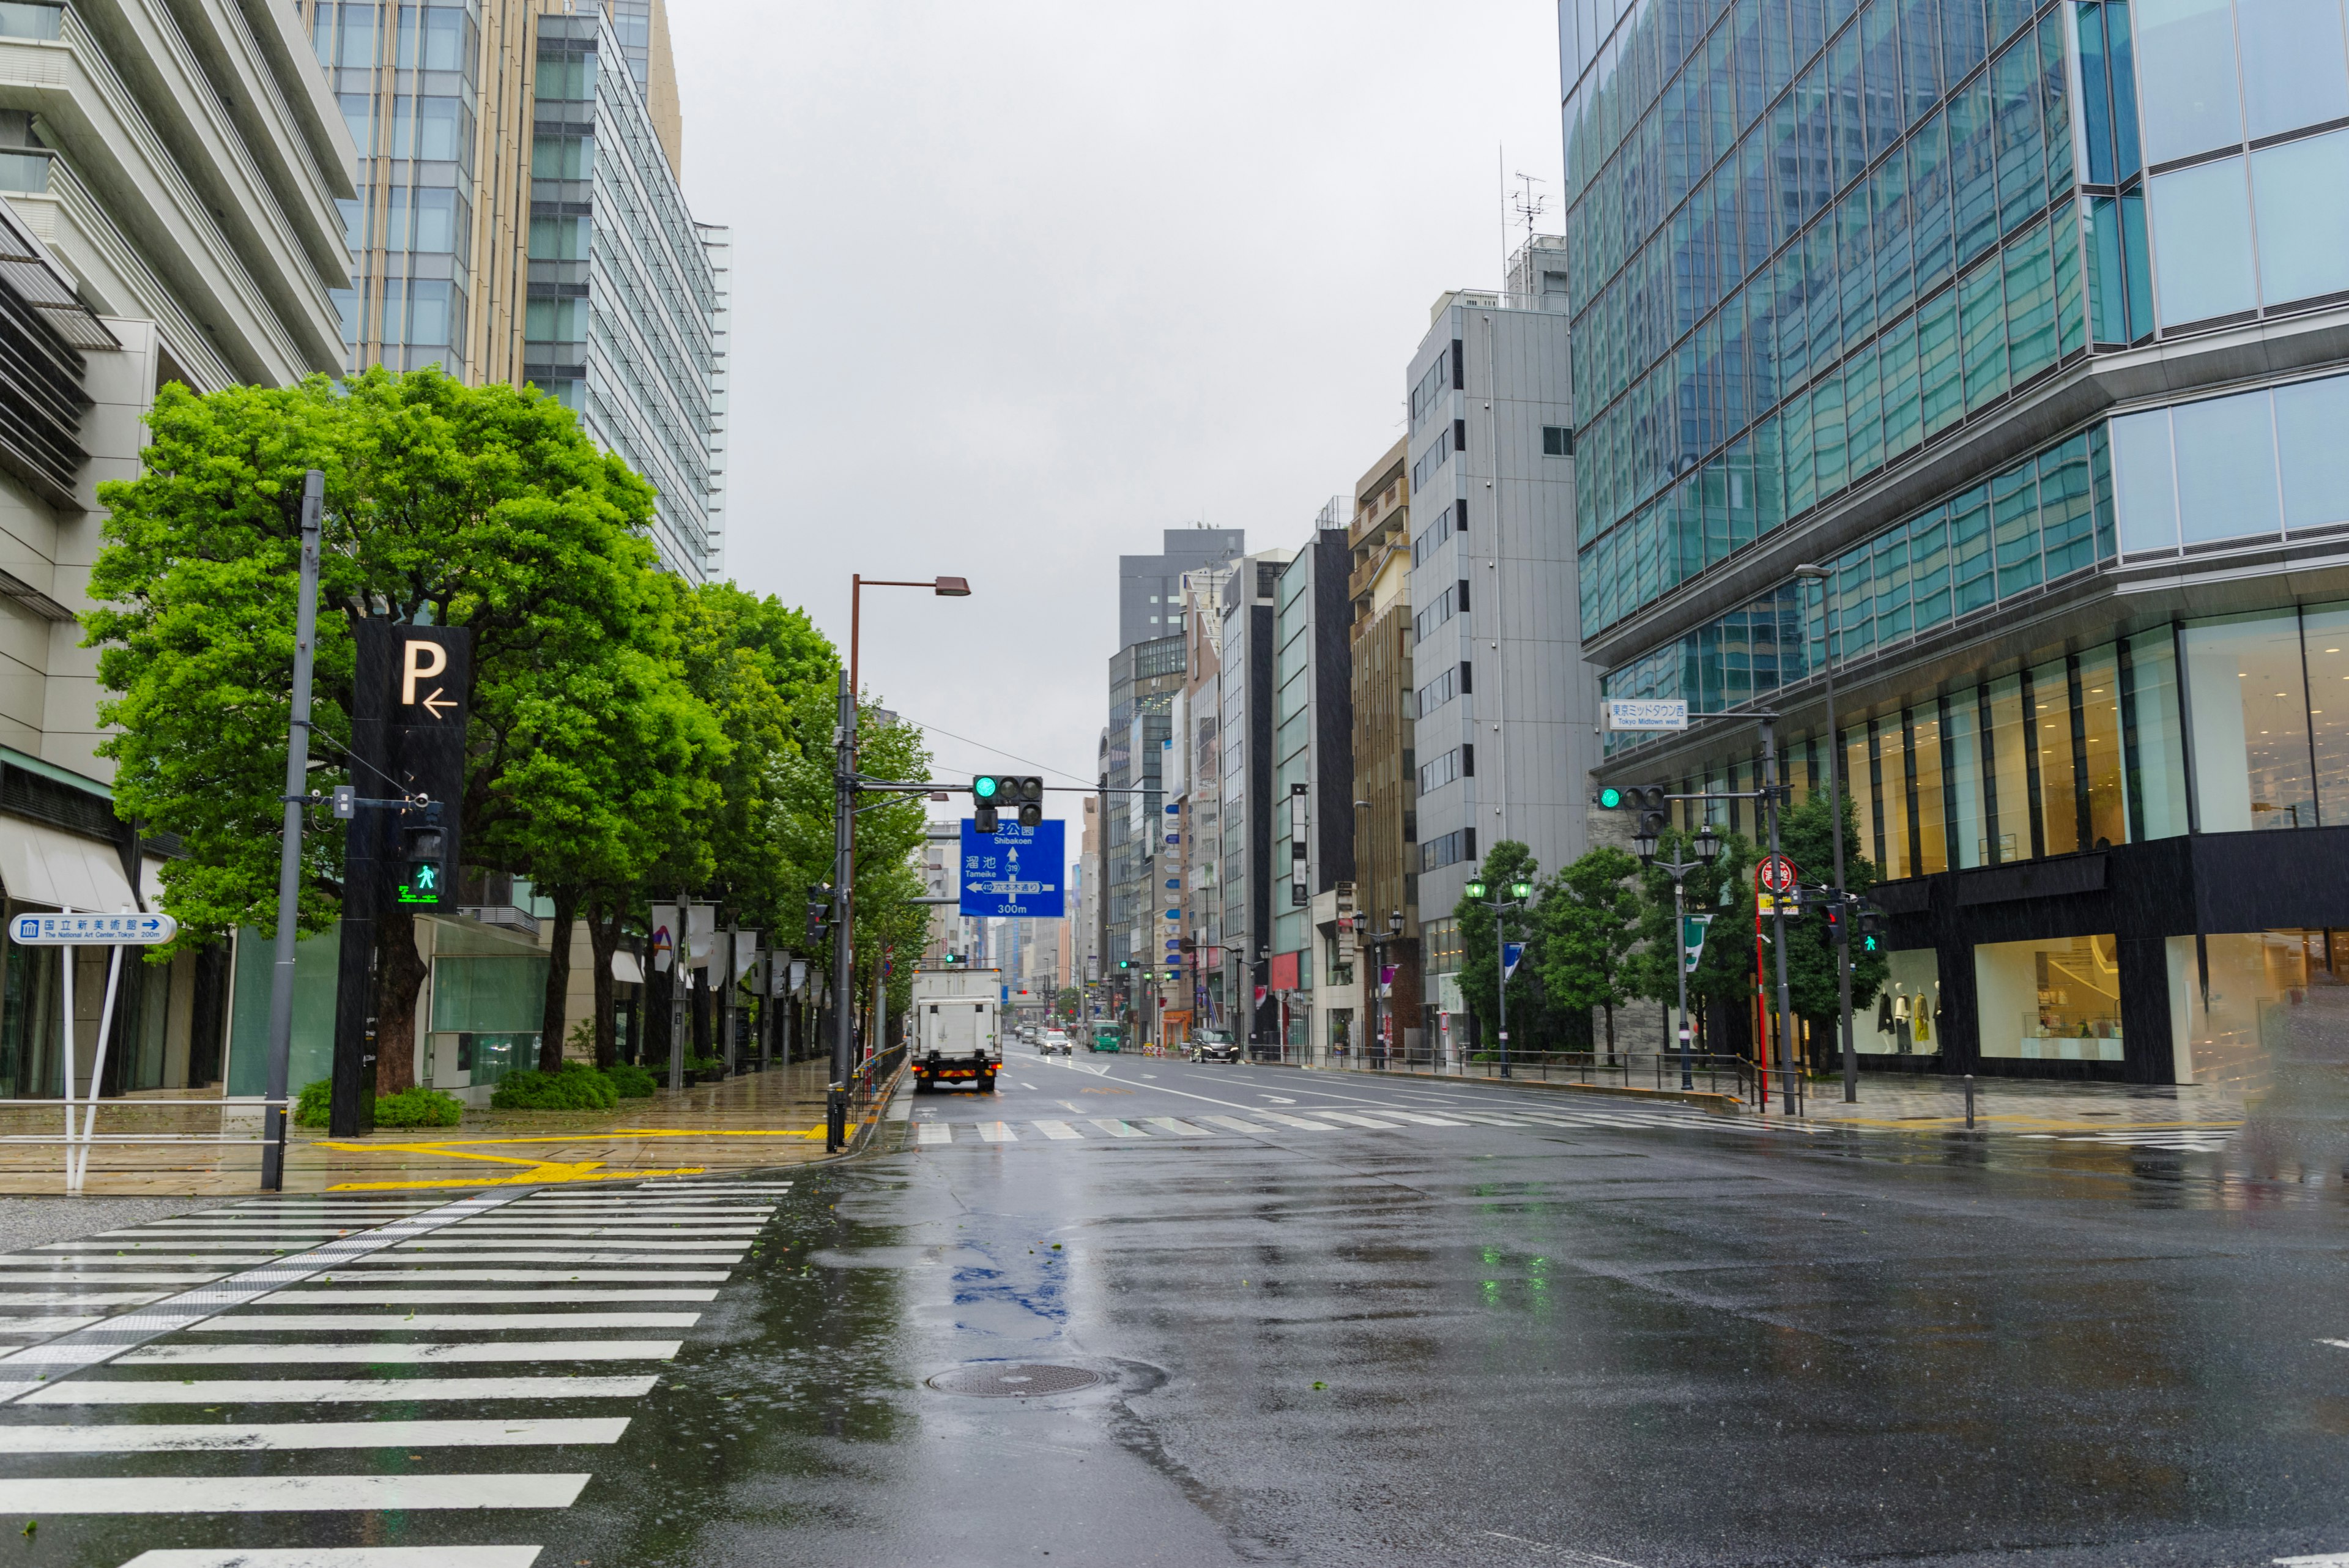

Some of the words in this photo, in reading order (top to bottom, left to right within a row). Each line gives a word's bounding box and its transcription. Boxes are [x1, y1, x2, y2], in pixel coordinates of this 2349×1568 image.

[403, 640, 447, 705] P
[1612, 705, 1684, 716] 東京ミッドタウン西
[965, 856, 996, 869] 溜池
[45, 920, 136, 930] 国立新美術館
